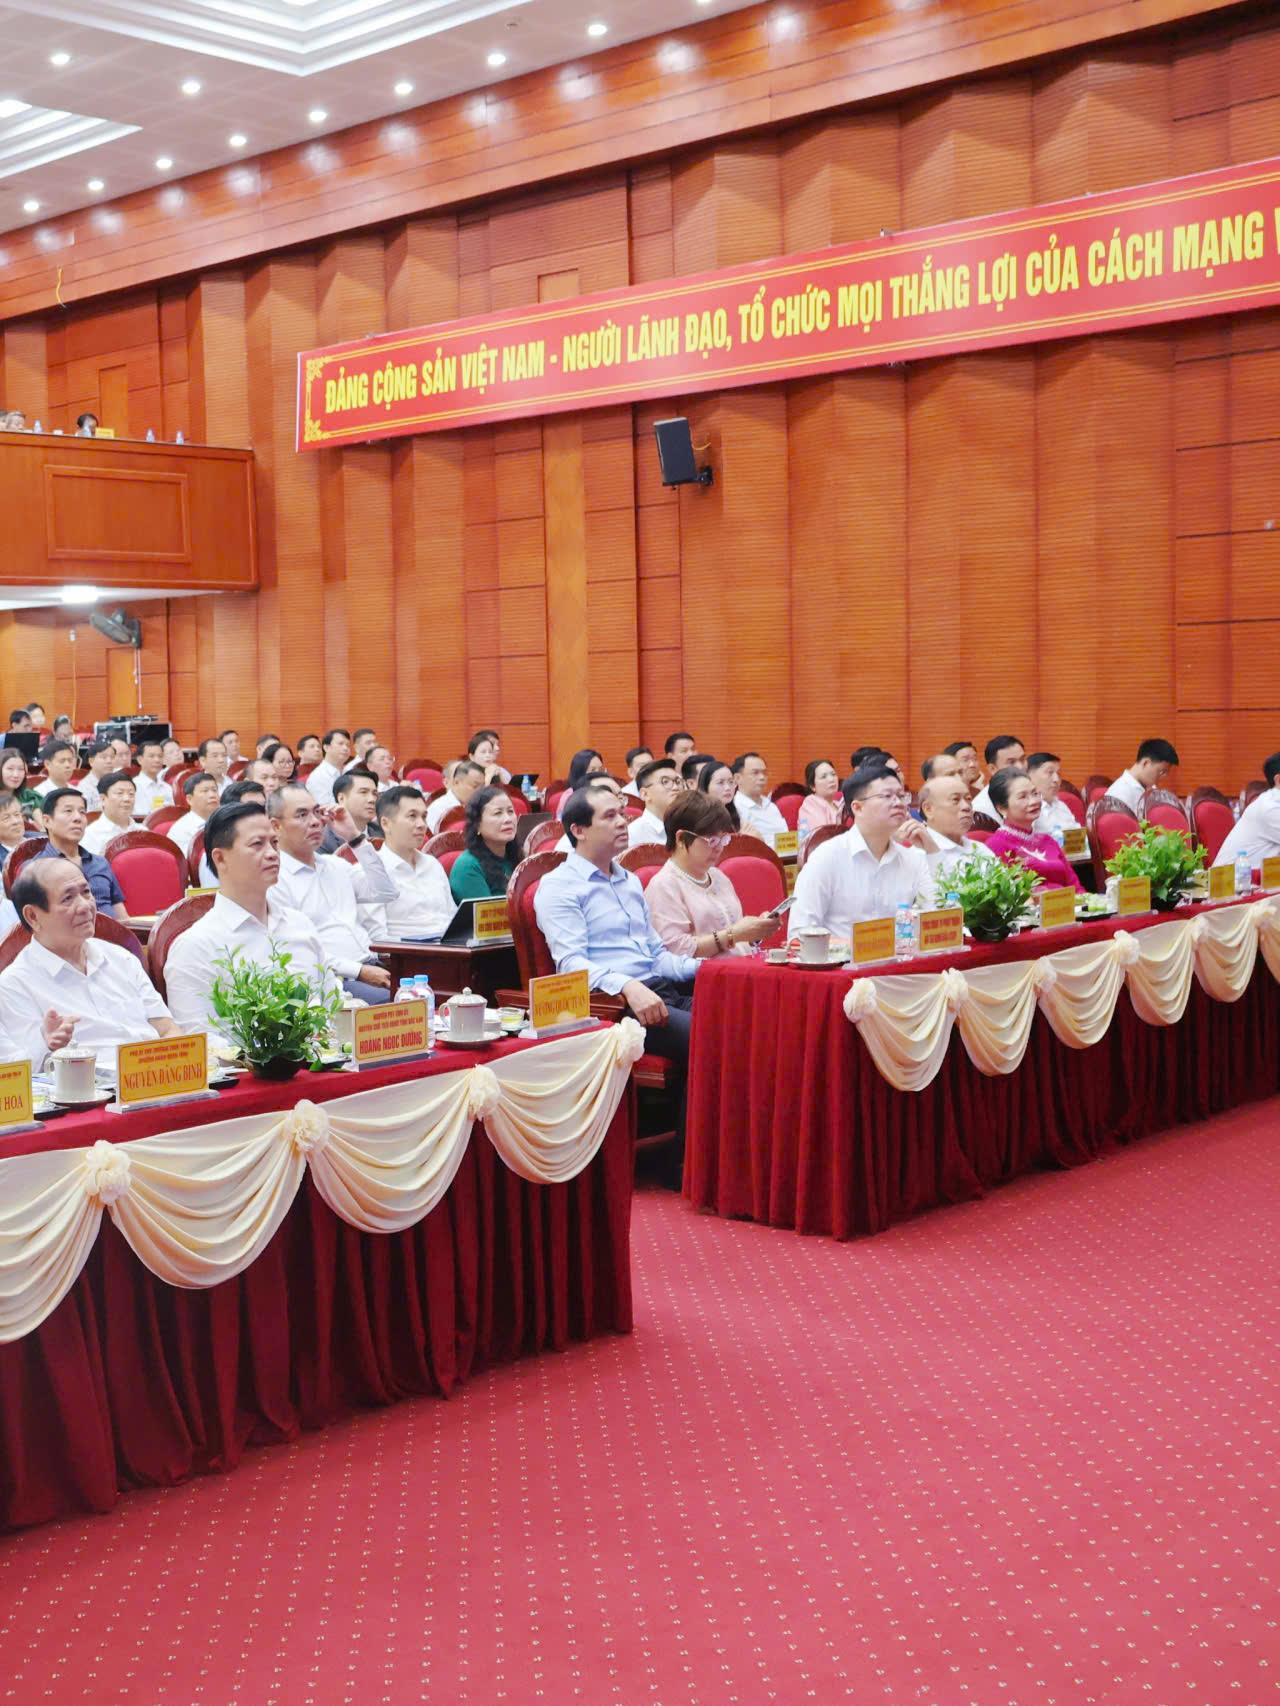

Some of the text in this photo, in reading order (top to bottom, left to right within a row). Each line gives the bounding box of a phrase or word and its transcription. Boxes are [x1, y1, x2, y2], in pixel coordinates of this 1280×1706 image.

[325, 366, 369, 413] ĐẢNG
[372, 361, 417, 410] CỘNG
[421, 347, 457, 396] SẢN
[461, 343, 498, 394] VIỆT
[502, 340, 545, 383] NAM
[563, 319, 621, 373] NGƯỜI
[627, 314, 679, 362] LÃNH
[685, 308, 732, 359] ĐẠO,
[738, 285, 766, 344] TỔ
[771, 283, 831, 339] CHỨC
[838, 280, 883, 333] MỌI
[889, 255, 970, 319] THẮNG
[978, 252, 1017, 312] LỢI
[1026, 233, 1079, 297] CỦA
[1087, 227, 1163, 287] CÁCH
[1173, 211, 1264, 278] MẠNG
[4, 1095, 23, 1111] HOA
